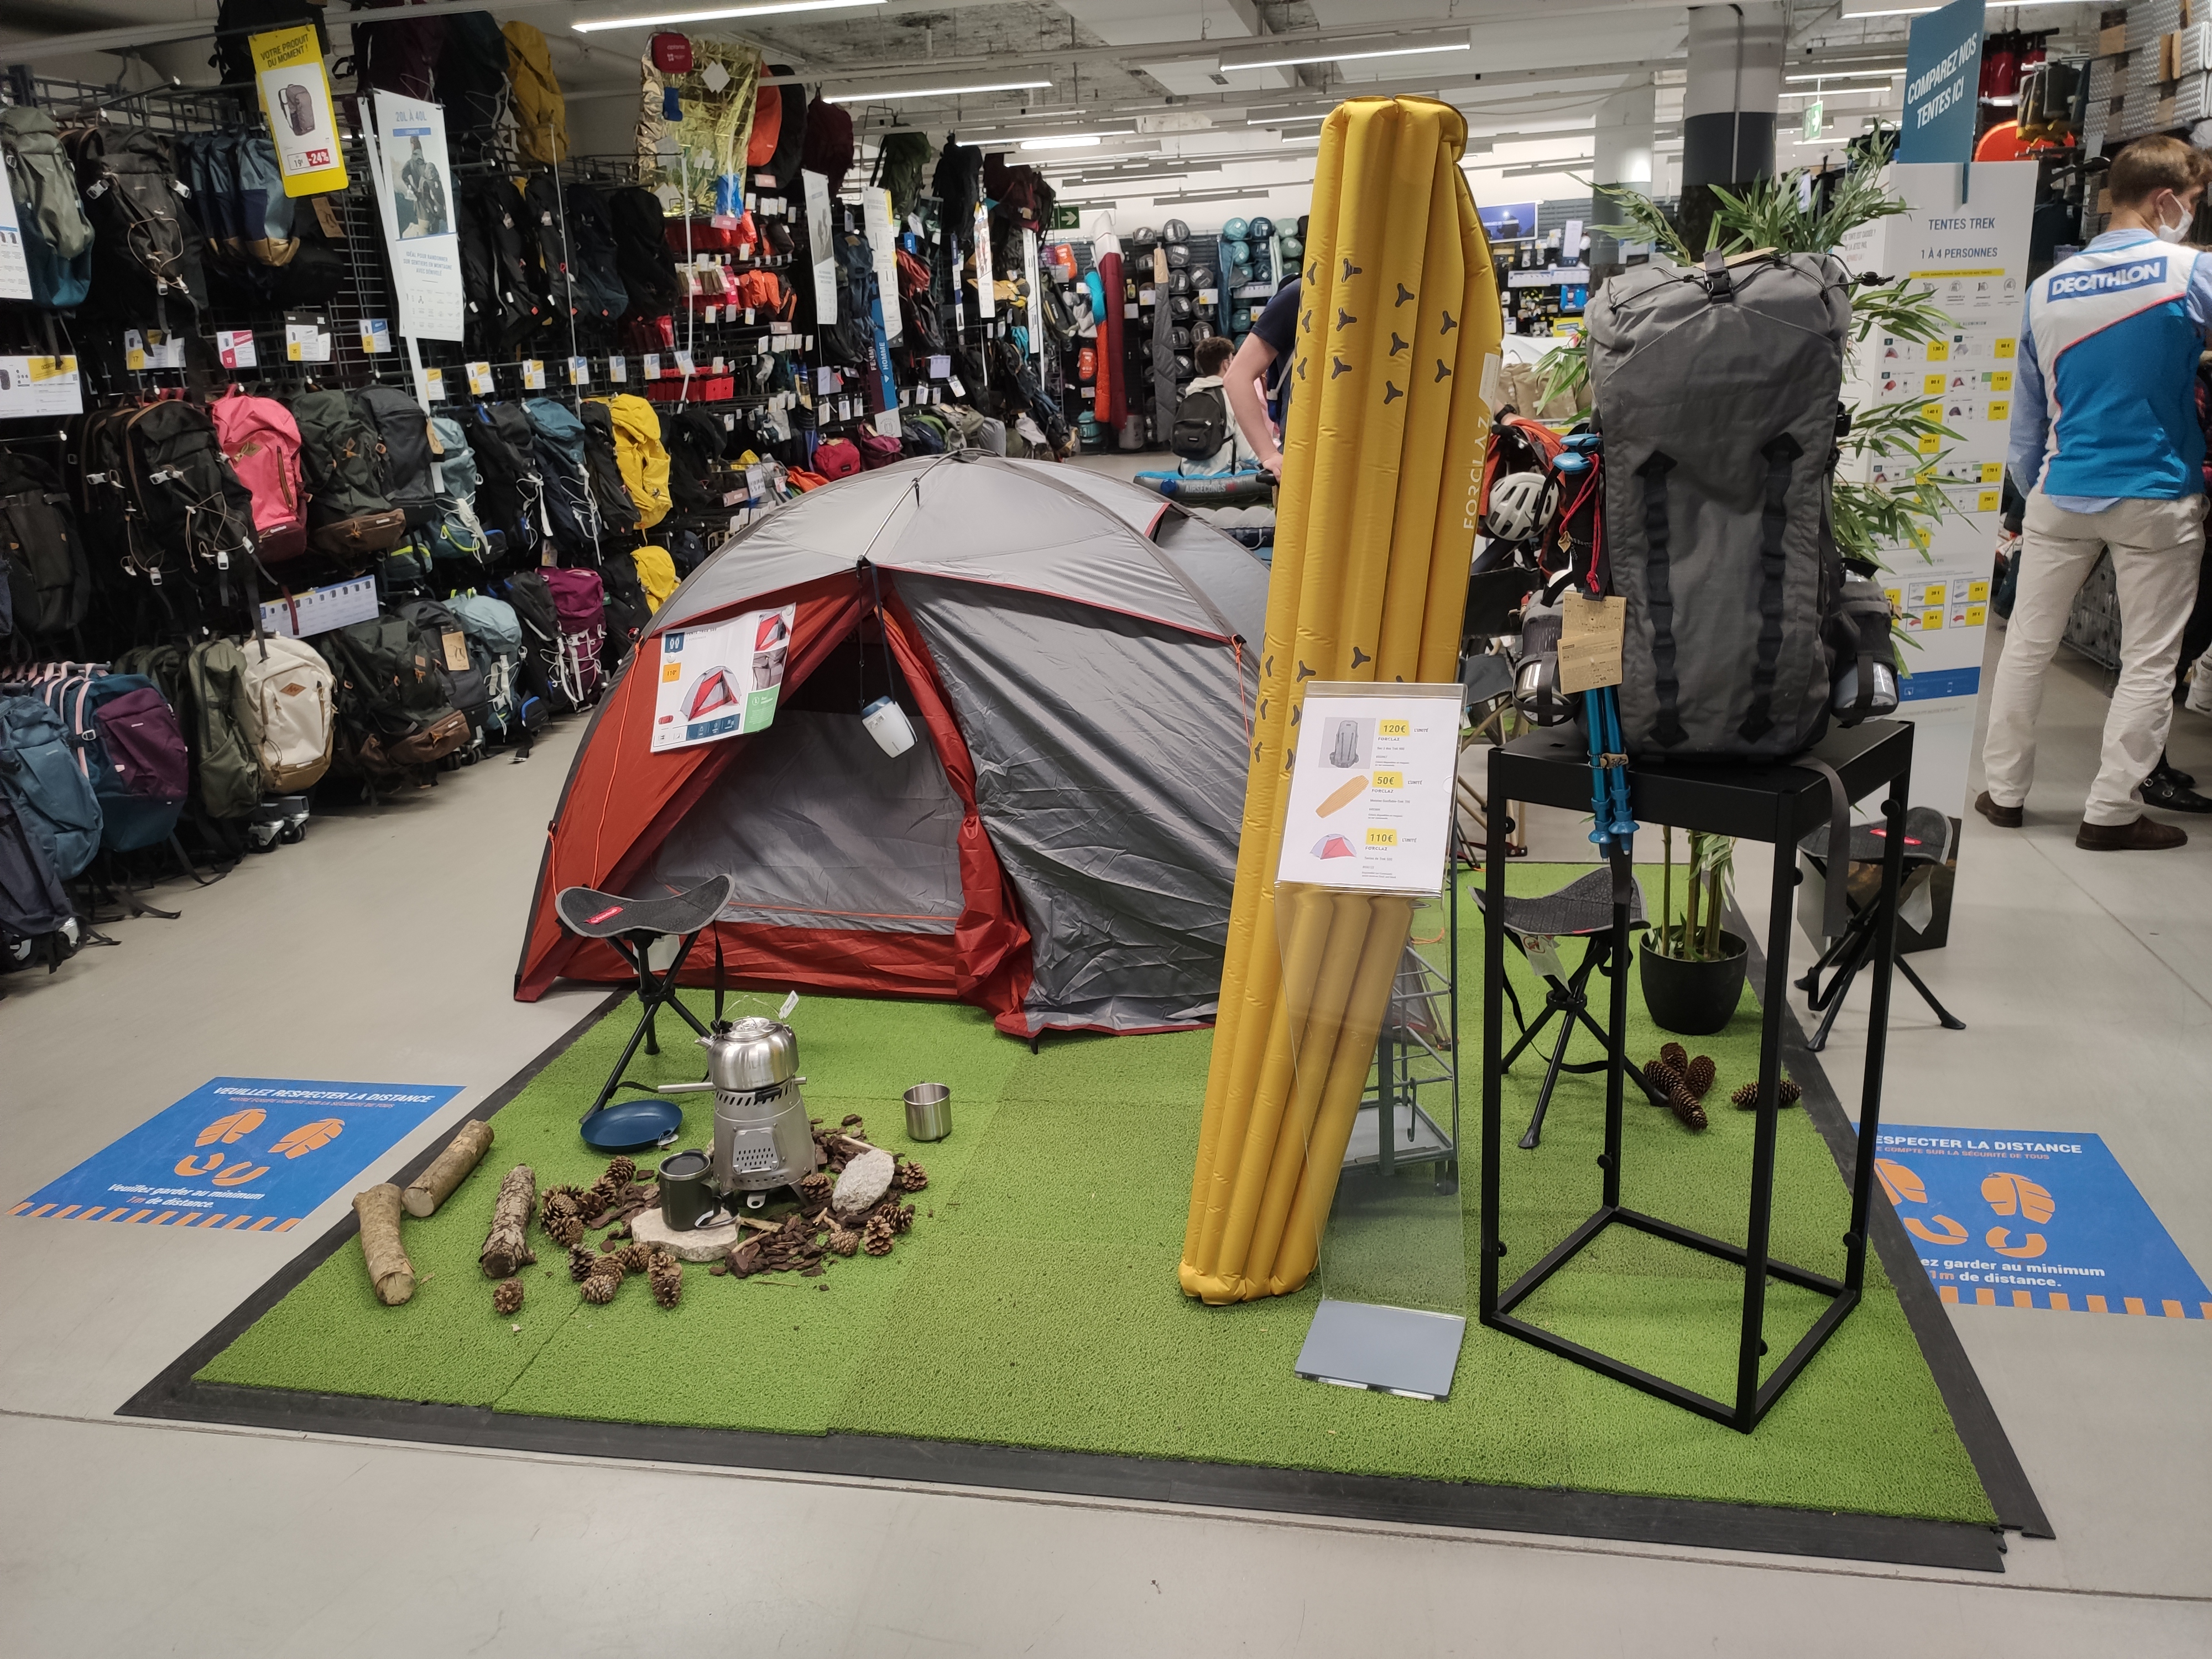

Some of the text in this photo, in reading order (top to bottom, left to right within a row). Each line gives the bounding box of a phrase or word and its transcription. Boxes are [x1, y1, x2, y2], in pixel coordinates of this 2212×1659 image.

[260, 34, 309, 61] VOTRE PRODUIT
[268, 58, 278, 67] DU
[278, 46, 305, 64] MOMENT
[1908, 32, 1977, 105] COMPAREZ NOS
[1917, 76, 1964, 129] TENTES ICI
[395, 109, 427, 122] 20L À 40L
[307, 152, 330, 165] -24%
[1928, 217, 1996, 230] TENTES TREK
[1921, 247, 1997, 259] 1 À 4 PERSONNES
[2052, 262, 2161, 295] DECATHLON
[879, 342, 889, 370] HOMME
[1463, 416, 1491, 529] FORCLAZ
[1383, 724, 1406, 733] 120€
[1377, 776, 1395, 785] 50€
[1370, 833, 1394, 843] 110€
[213, 1087, 276, 1097] VEUILLEZ
[271, 1089, 349, 1099] RESPECTER
[365, 1094, 436, 1103] DISTANCE
[1876, 1135, 2083, 1154] ESPECTER LA DISTANCE
[107, 1183, 155, 1193] Veuillez
[149, 1187, 195, 1196] garder
[207, 1190, 265, 1200] minimum
[126, 1196, 214, 1208] 1m de distance.
[1944, 1259, 1997, 1270] garder
[2002, 1262, 2022, 1271] au
[2027, 1263, 2105, 1276] minimum
[1929, 1270, 2062, 1287] 1m de distance.
